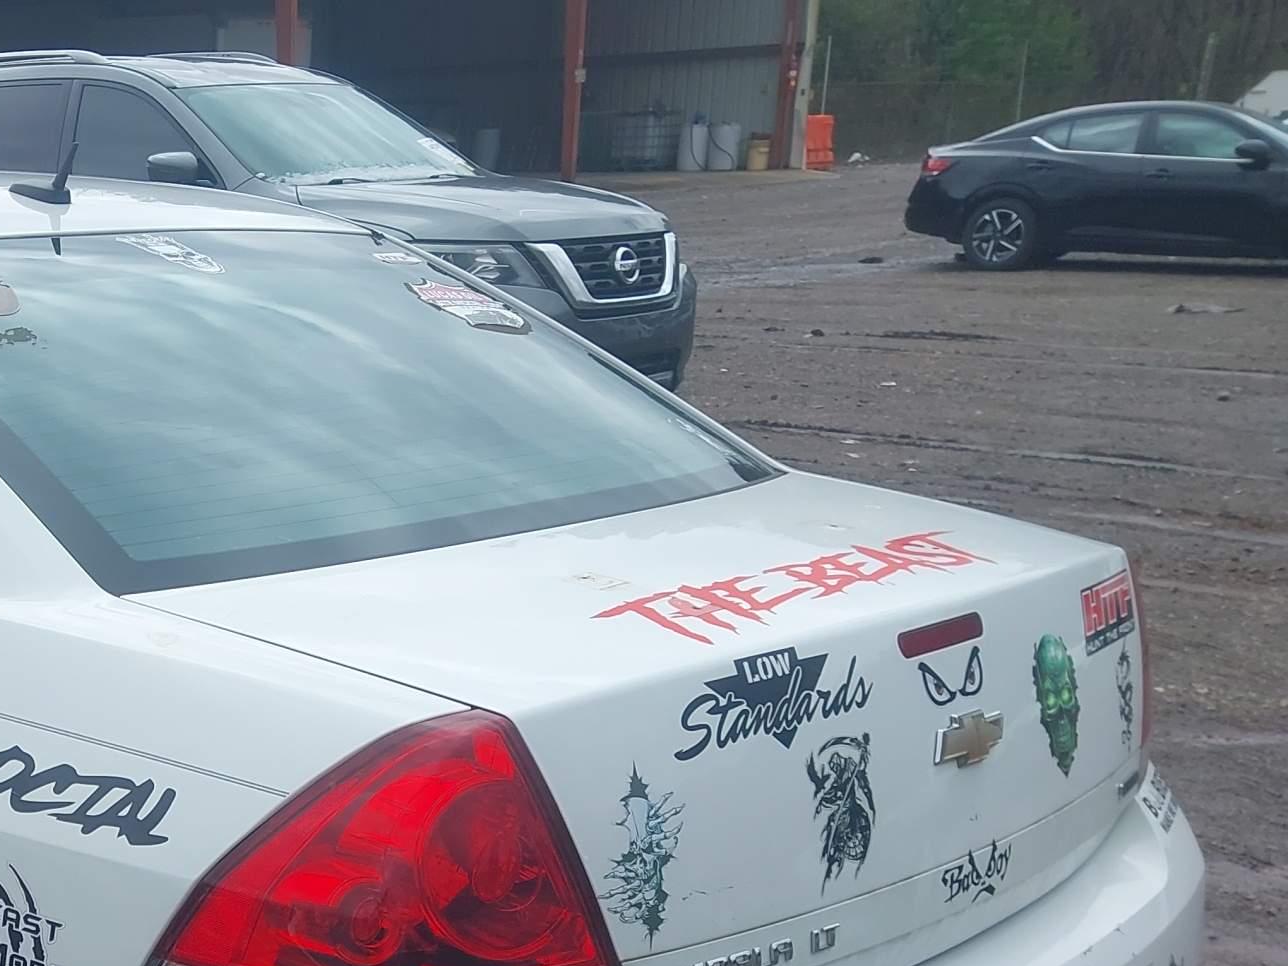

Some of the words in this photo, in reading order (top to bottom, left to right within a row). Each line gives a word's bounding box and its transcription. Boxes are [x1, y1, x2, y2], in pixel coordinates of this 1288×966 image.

[590, 574, 813, 645] THE
[763, 531, 998, 599] BEAST
[744, 651, 791, 684] LOW
[674, 655, 873, 761] Standards
[941, 849, 983, 903] Bad
[810, 923, 840, 953] LT
